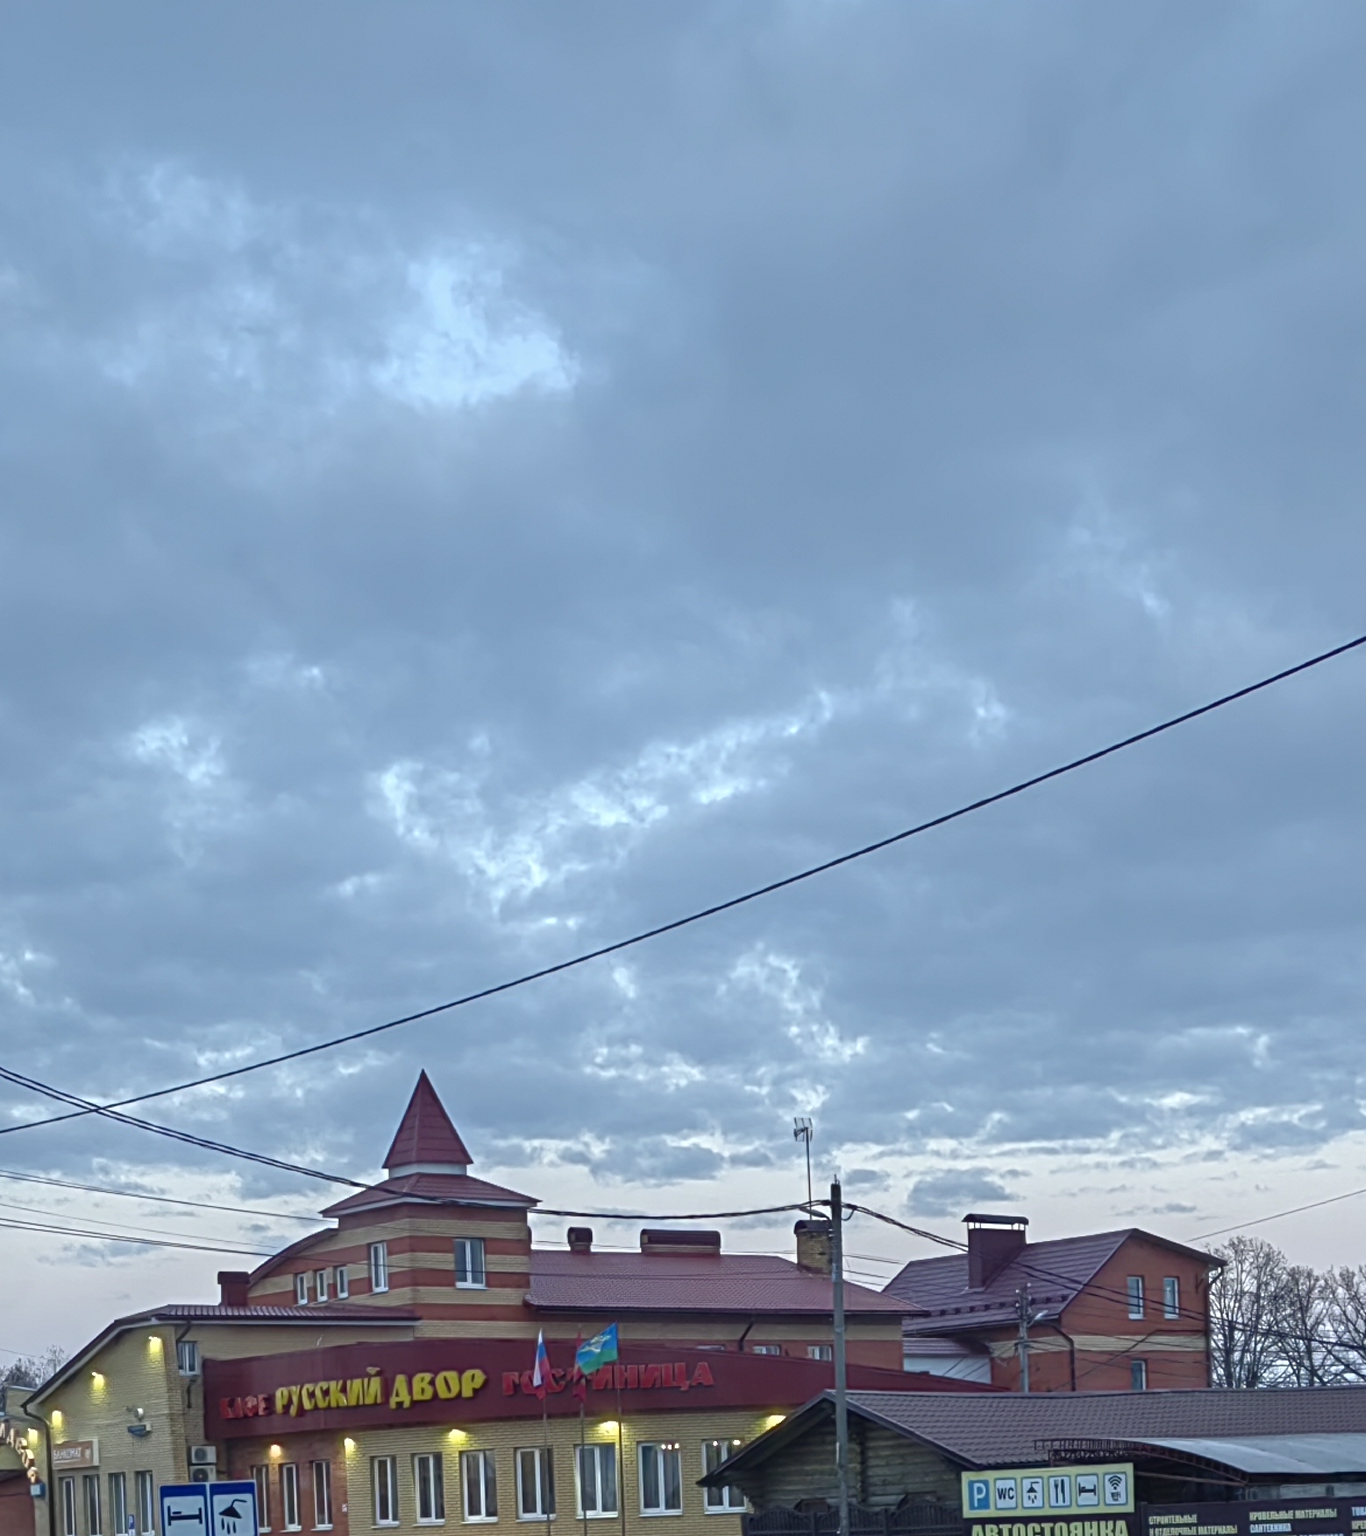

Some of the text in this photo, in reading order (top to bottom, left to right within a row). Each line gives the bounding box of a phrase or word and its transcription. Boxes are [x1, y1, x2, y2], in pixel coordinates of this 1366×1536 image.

[220, 1393, 270, 1420] КАФЕ
[275, 1366, 383, 1417] РУССКИЙ
[389, 1369, 487, 1409] ДВОР
[997, 1487, 1015, 1500] WC
[1149, 1514, 1198, 1525] СТРОИТЕЛЬНЫЕ
[1249, 1508, 1337, 1521] КРОВЕЛЬНЫЕ МАТЕРИАЛЫ
[1198, 1524, 1238, 1535] МАТЕРИАЛЫ
